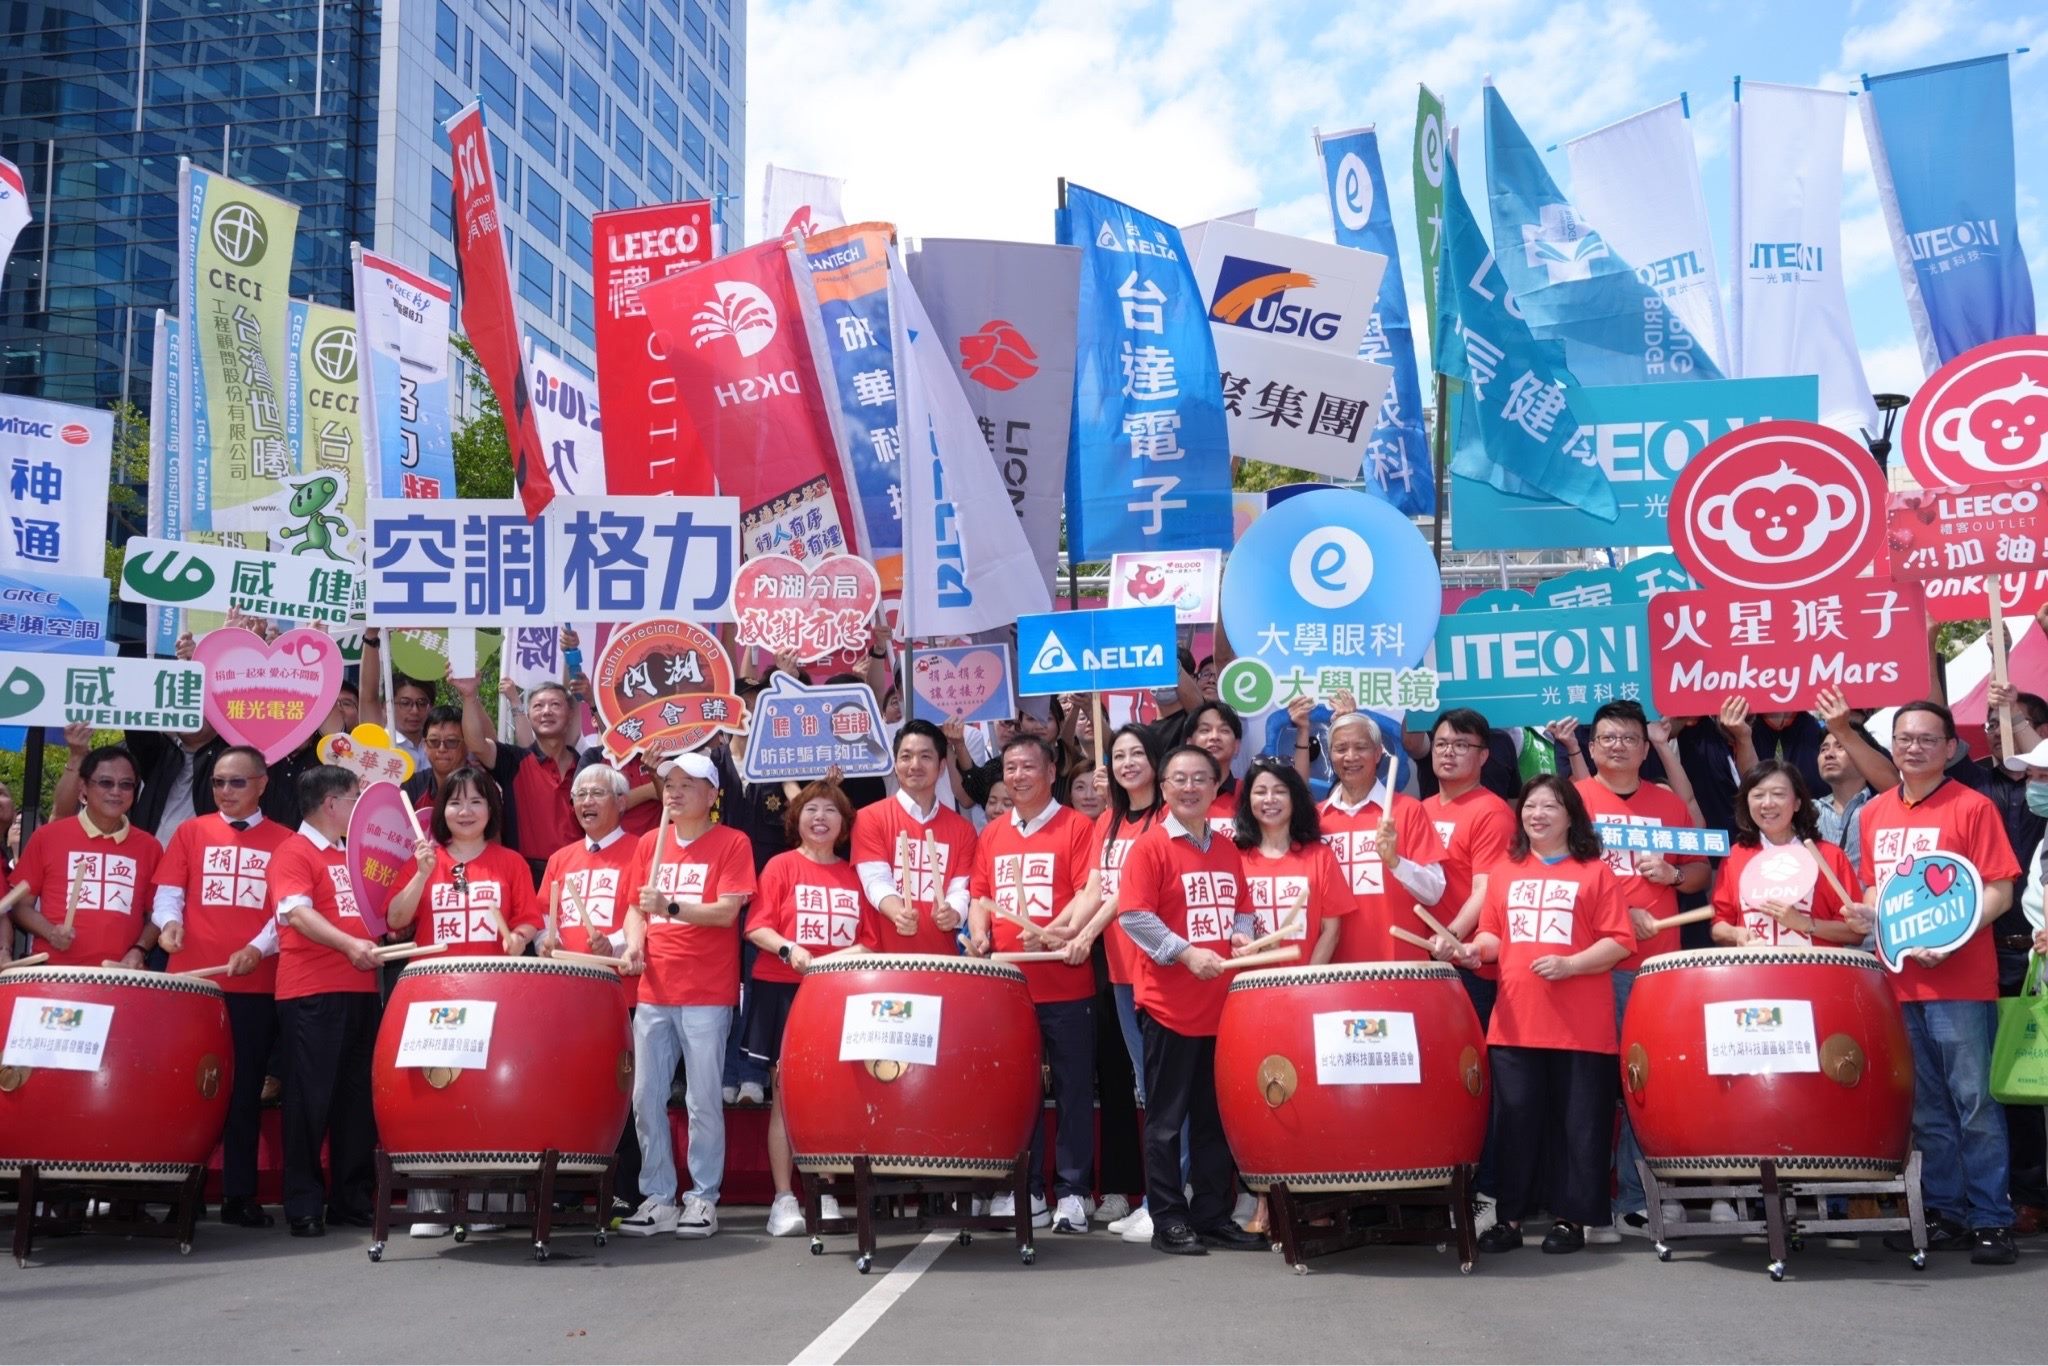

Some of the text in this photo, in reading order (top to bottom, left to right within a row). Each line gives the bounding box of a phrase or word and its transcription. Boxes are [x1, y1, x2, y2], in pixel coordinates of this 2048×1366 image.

[190, 184, 203, 225] CECI
[608, 225, 698, 263] LEECO
[1127, 239, 1178, 262] DELTA
[209, 269, 262, 302] CECI
[291, 315, 302, 349] CECI
[1250, 298, 1341, 341] USIG
[169, 334, 180, 368] CECI
[212, 299, 247, 481] 工程顧問股份有限公司
[288, 353, 298, 434] Engineering
[309, 388, 359, 414] CECI
[1117, 270, 1187, 535] 台達電子
[167, 371, 180, 453] Engineering
[196, 458, 208, 510] Taiwan
[11, 458, 62, 563] 神通
[1938, 490, 2038, 520] LEECO
[755, 506, 822, 553] 行人有序
[1972, 517, 2037, 531] OUTLET
[373, 511, 732, 615] 空調 格力
[3, 589, 59, 605] GREE
[230, 560, 352, 606] 威健
[754, 575, 858, 599] 內湖分局
[230, 597, 346, 622] WEIKENG
[1661, 591, 1910, 651] 火星猴子
[737, 608, 868, 651] 感謝有您
[1257, 622, 1406, 658] 大學眼科
[601, 623, 720, 687] Neihu Precinct TCPD
[1083, 645, 1164, 670] DELTA
[1424, 625, 1639, 682] LITEON
[64, 667, 202, 710] 威健
[1279, 668, 1435, 709] 大學眼鏡
[1669, 652, 1898, 703] Monkey Mars
[1542, 682, 1640, 705] 光寶科技
[66, 709, 200, 728] WEIKENG
[227, 700, 304, 720] 雅光電器
[833, 713, 870, 735] 查證
[773, 717, 790, 737] 聽
[802, 715, 818, 736] 掛
[761, 743, 868, 765] 防詐騙有夠正
[1601, 827, 1725, 852] 新高橋藥局
[209, 849, 265, 871] 捐血
[363, 857, 398, 887] 雅光
[204, 880, 261, 901] 救人
[435, 886, 497, 906] 捐血
[800, 891, 858, 910] 捐血
[1189, 876, 1236, 902] 捐血
[1512, 882, 1571, 904] 捐血
[1751, 886, 1799, 899] LION
[1885, 890, 1913, 916] WE
[438, 917, 495, 940] 救人
[800, 919, 856, 941] 救人
[1512, 914, 1568, 936] 救人
[1890, 897, 1965, 945] LITEON
